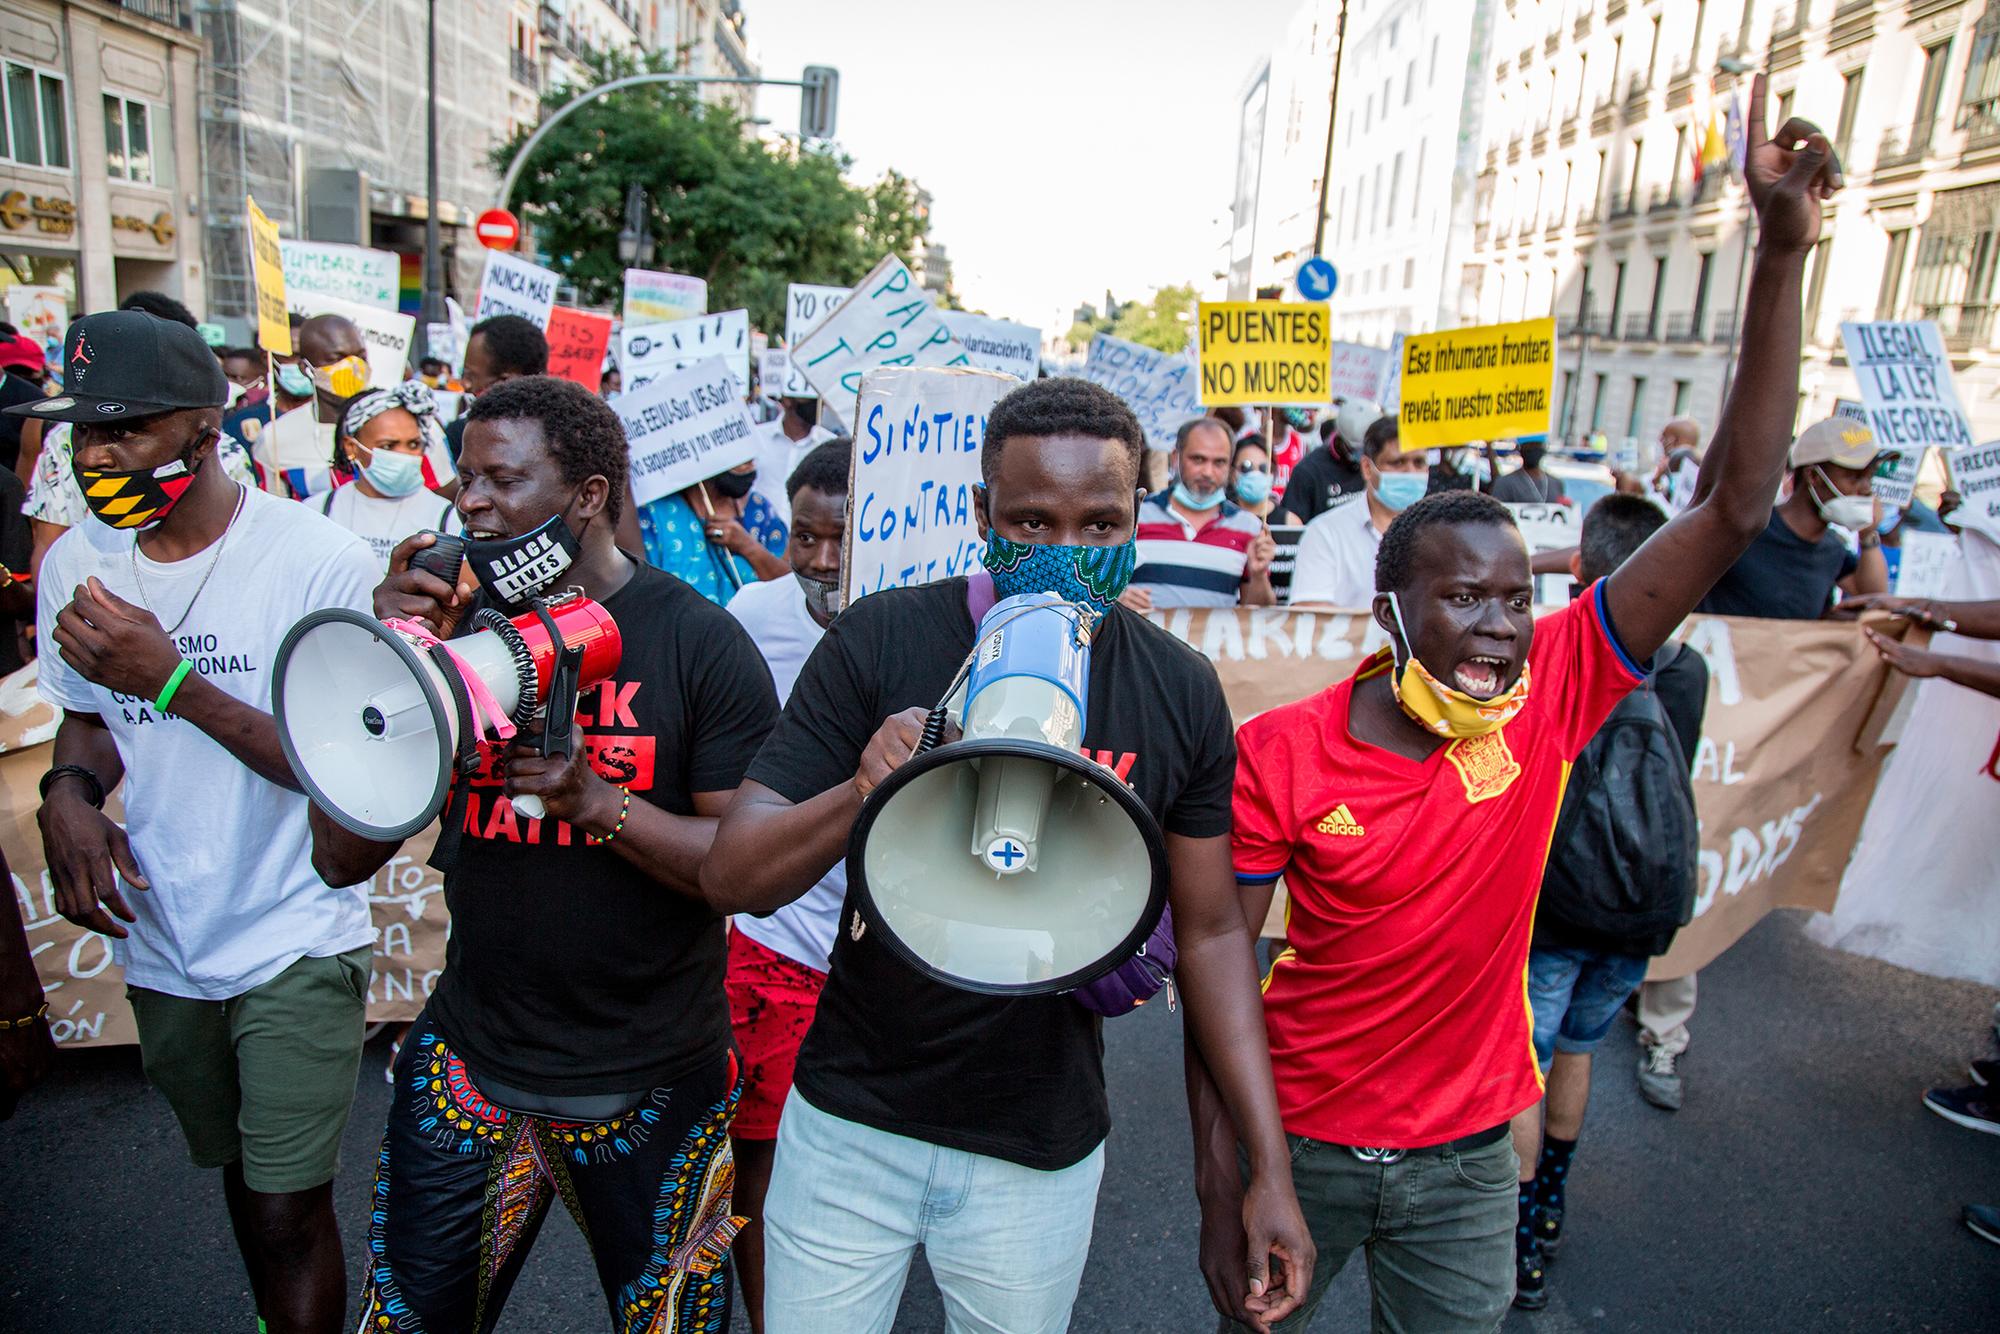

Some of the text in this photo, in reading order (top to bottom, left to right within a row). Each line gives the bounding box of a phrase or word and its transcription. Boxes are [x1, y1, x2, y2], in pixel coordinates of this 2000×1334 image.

[1202, 310, 1328, 352] ¡PUENTES,
[1407, 343, 1432, 376] Esa
[1434, 340, 1498, 373] inhumana
[1501, 333, 1550, 367] frontera
[1202, 361, 1236, 395] NO
[1243, 360, 1327, 393] MUROS!
[1873, 366, 1942, 401] LA LEY
[1402, 391, 1442, 425] revela
[1444, 386, 1493, 421] nuestro
[1496, 384, 1547, 416] sistema.
[1870, 407, 1971, 445] NEGRERA
[859, 480, 986, 543] CONTRA
[489, 531, 554, 578] BLACK
[505, 553, 560, 591] LIVES
[186, 654, 257, 676] IONAL
[1316, 822, 1366, 837] adidas
